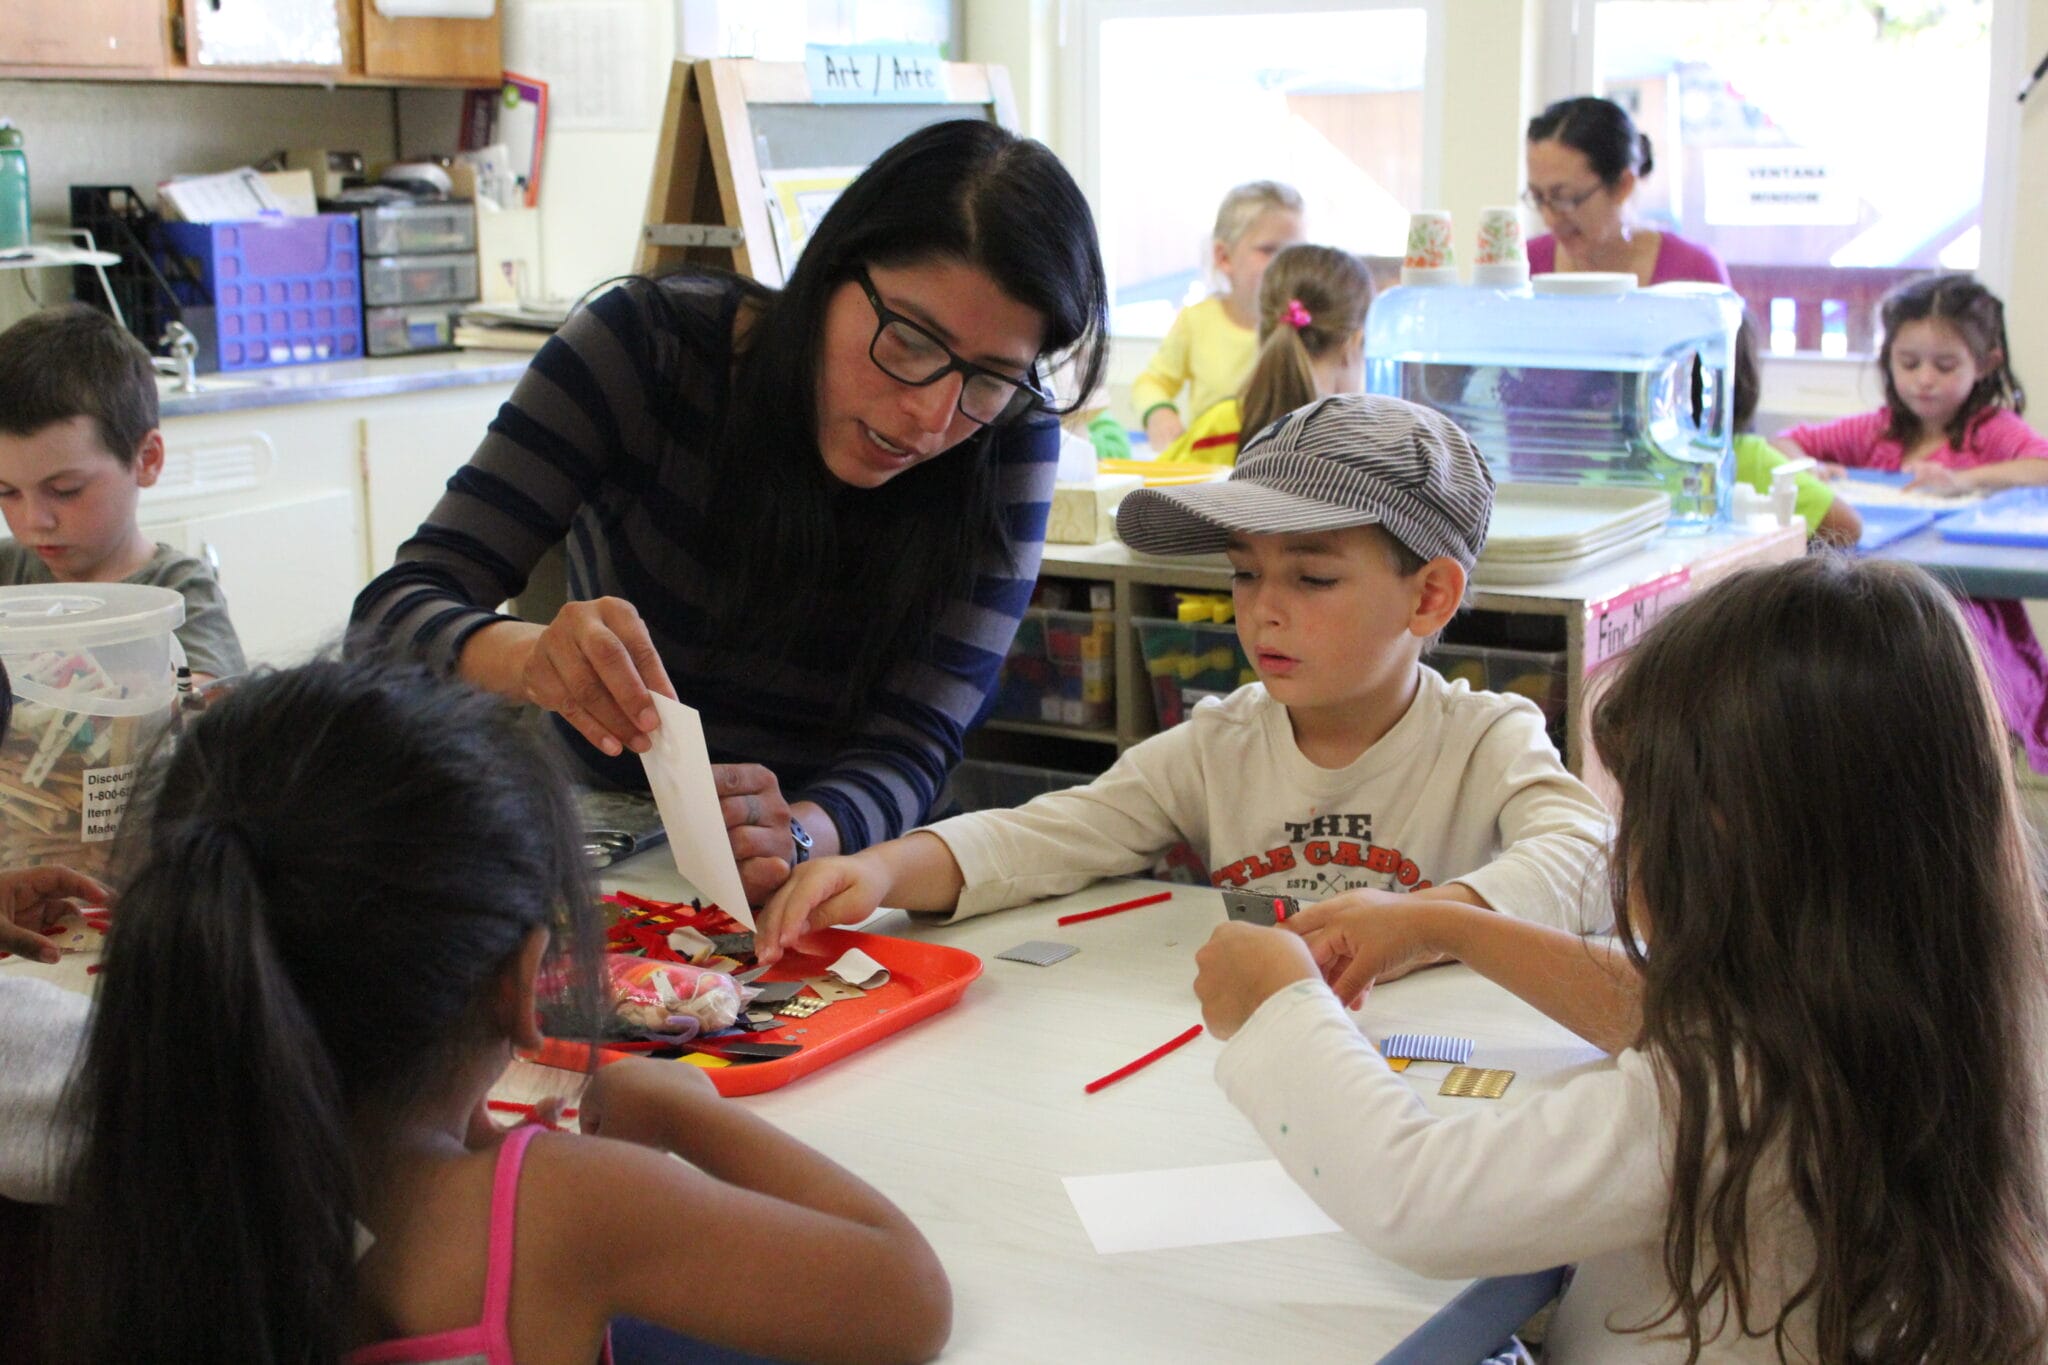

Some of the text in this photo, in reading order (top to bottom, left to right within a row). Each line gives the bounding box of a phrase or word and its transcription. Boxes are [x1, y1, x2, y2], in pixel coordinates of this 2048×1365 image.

[825, 54, 862, 88] Art
[892, 55, 936, 91] Arte
[1747, 166, 1825, 179] VENTANA
[87, 808, 111, 818] Item
[87, 823, 117, 835] Made
[1284, 813, 1372, 843] THE
[1303, 840, 1433, 893] CABO
